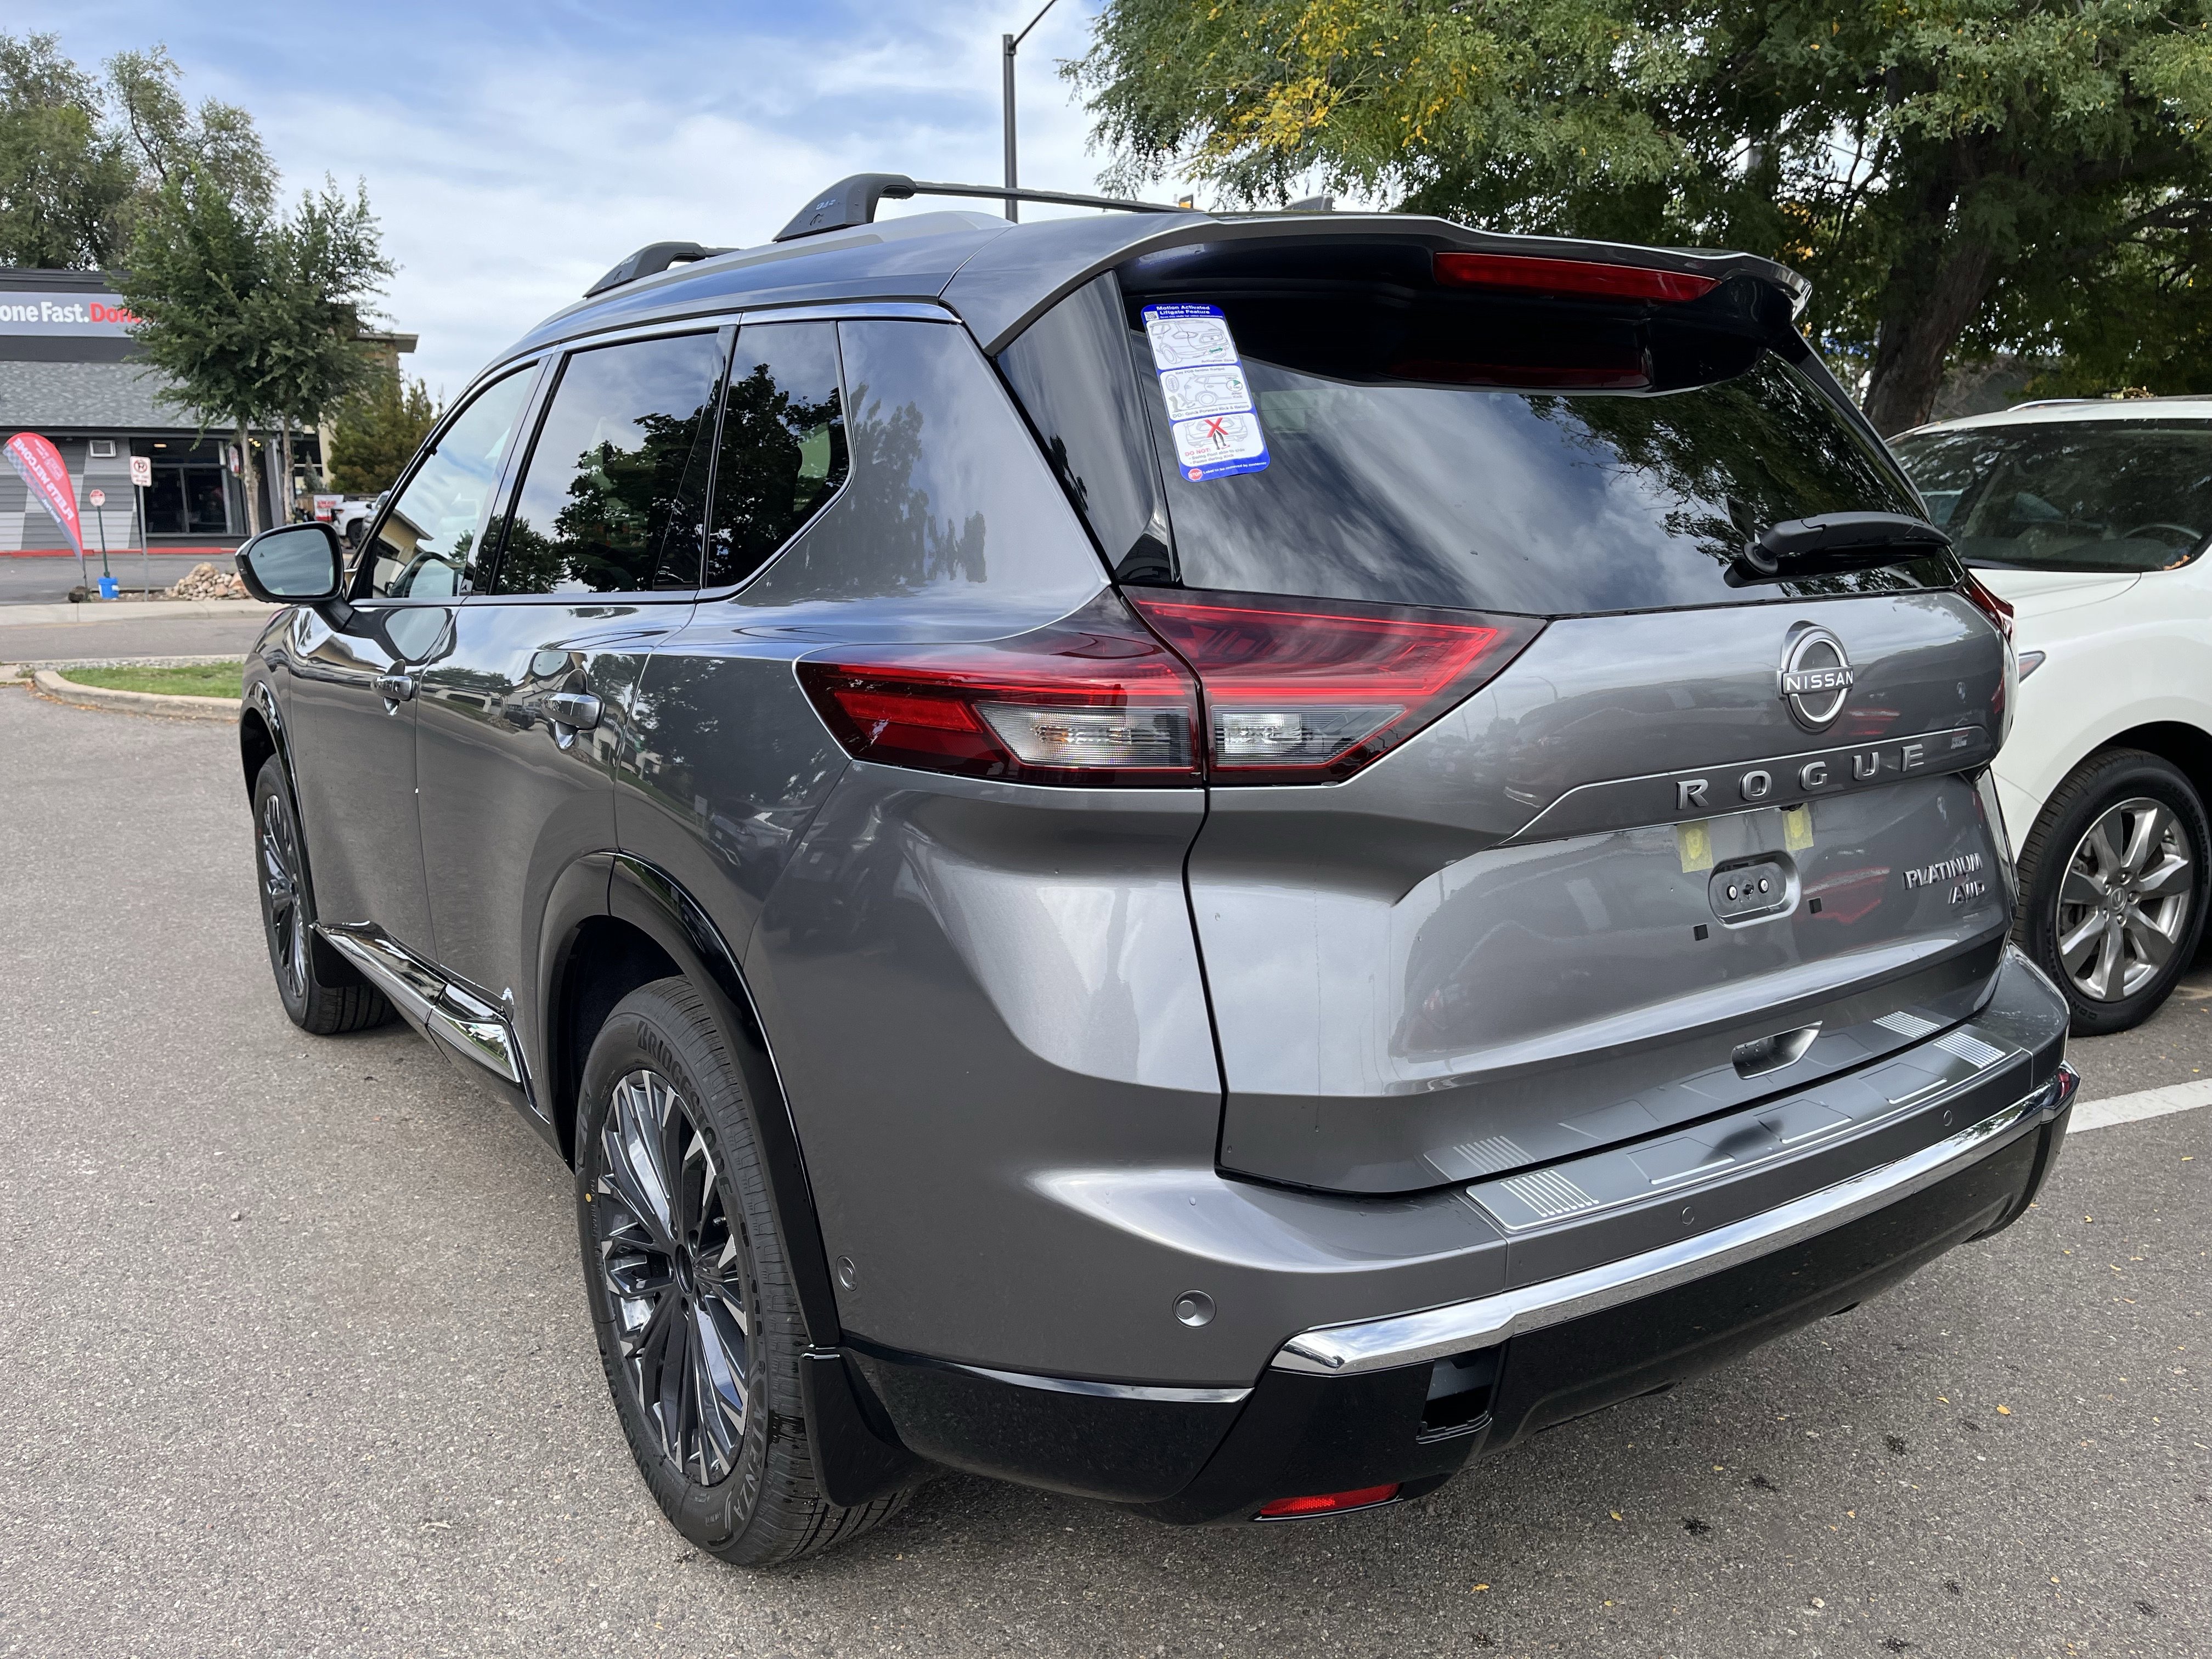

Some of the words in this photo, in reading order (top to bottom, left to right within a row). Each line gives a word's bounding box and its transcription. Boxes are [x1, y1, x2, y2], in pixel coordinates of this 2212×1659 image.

[41, 301, 89, 323] Fast.
[1786, 670, 1853, 691] NISSAN
[1677, 743, 1925, 810] ROGUE
[1904, 853, 1983, 889] PLATINUM
[1949, 880, 1985, 904] AWD
[637, 1020, 732, 1195] BRIDGESTONE
